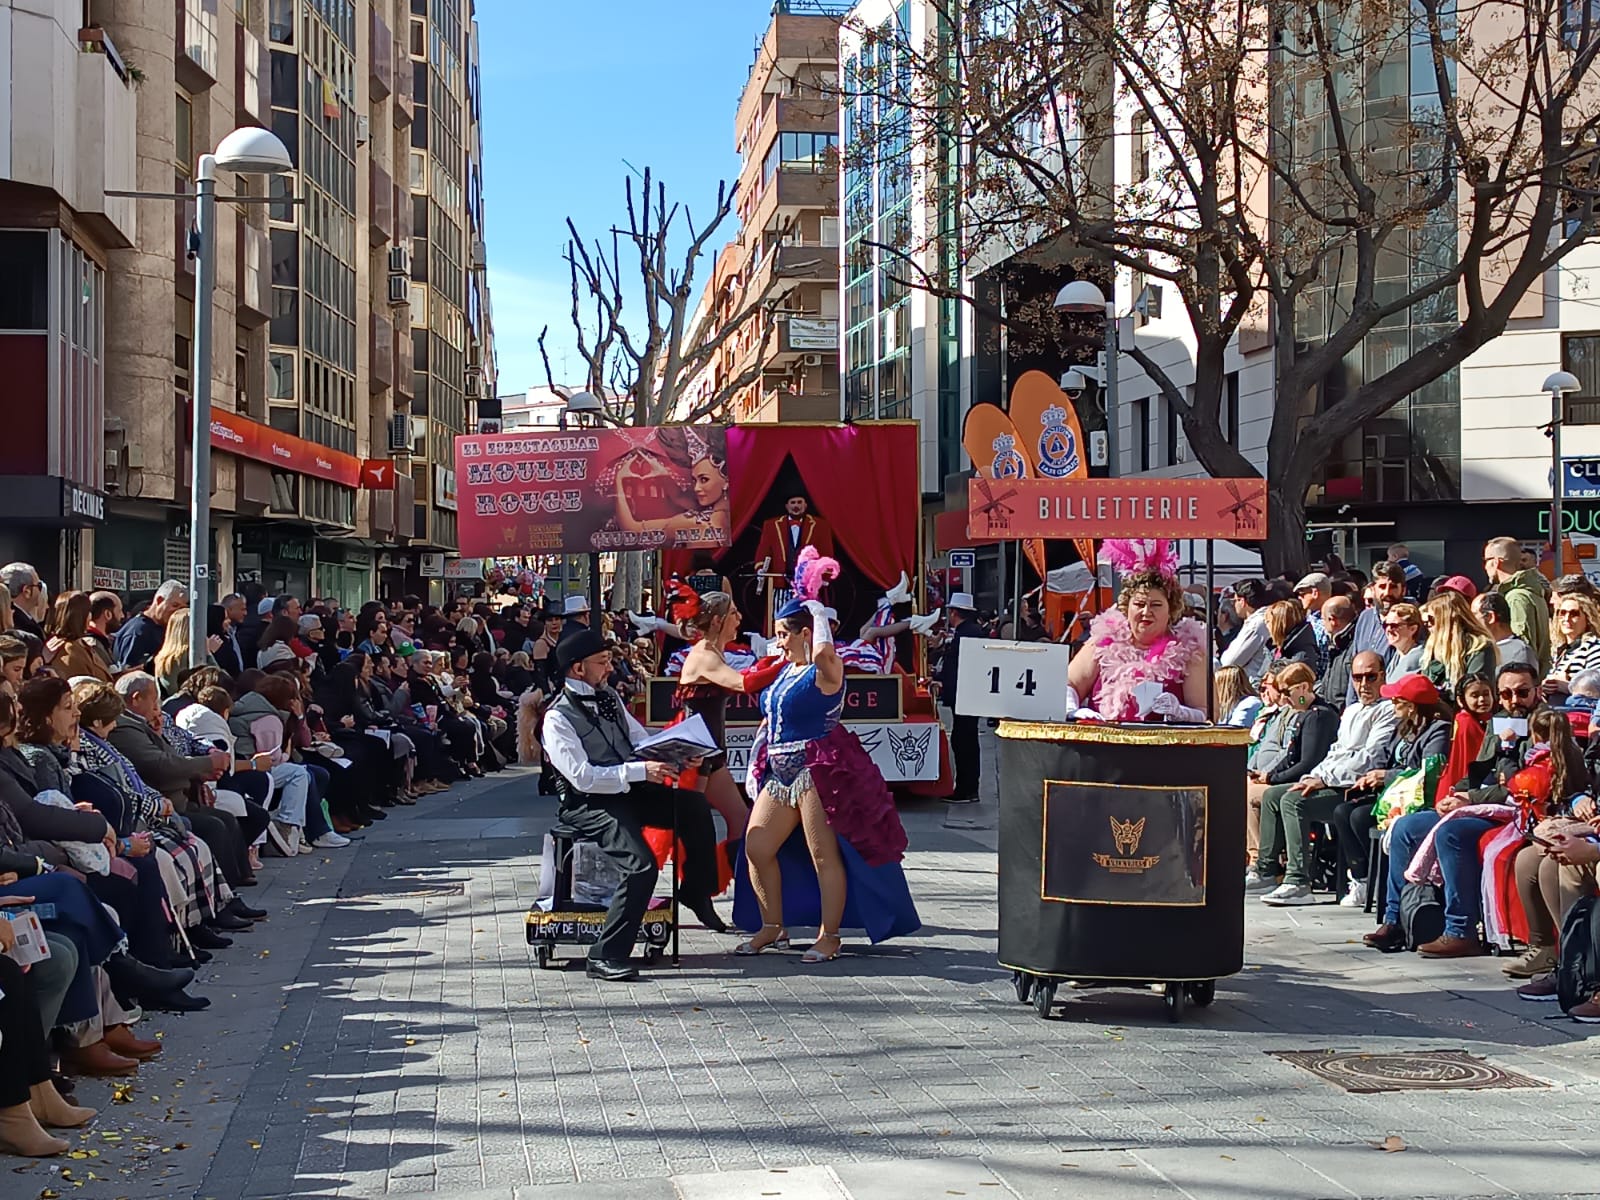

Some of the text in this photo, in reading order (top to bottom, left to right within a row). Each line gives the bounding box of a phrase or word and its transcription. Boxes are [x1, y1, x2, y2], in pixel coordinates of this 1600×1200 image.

[462, 436, 599, 457] EL ESPECTACULAR
[467, 458, 588, 486] MOULIN
[72, 488, 104, 520] DECIMAS
[474, 489, 583, 517] ROUGE
[1038, 496, 1199, 520] BILLETTERIE
[590, 527, 727, 547] CIUDAD REAL
[534, 922, 560, 938] HENRY
[562, 922, 574, 934] DE
